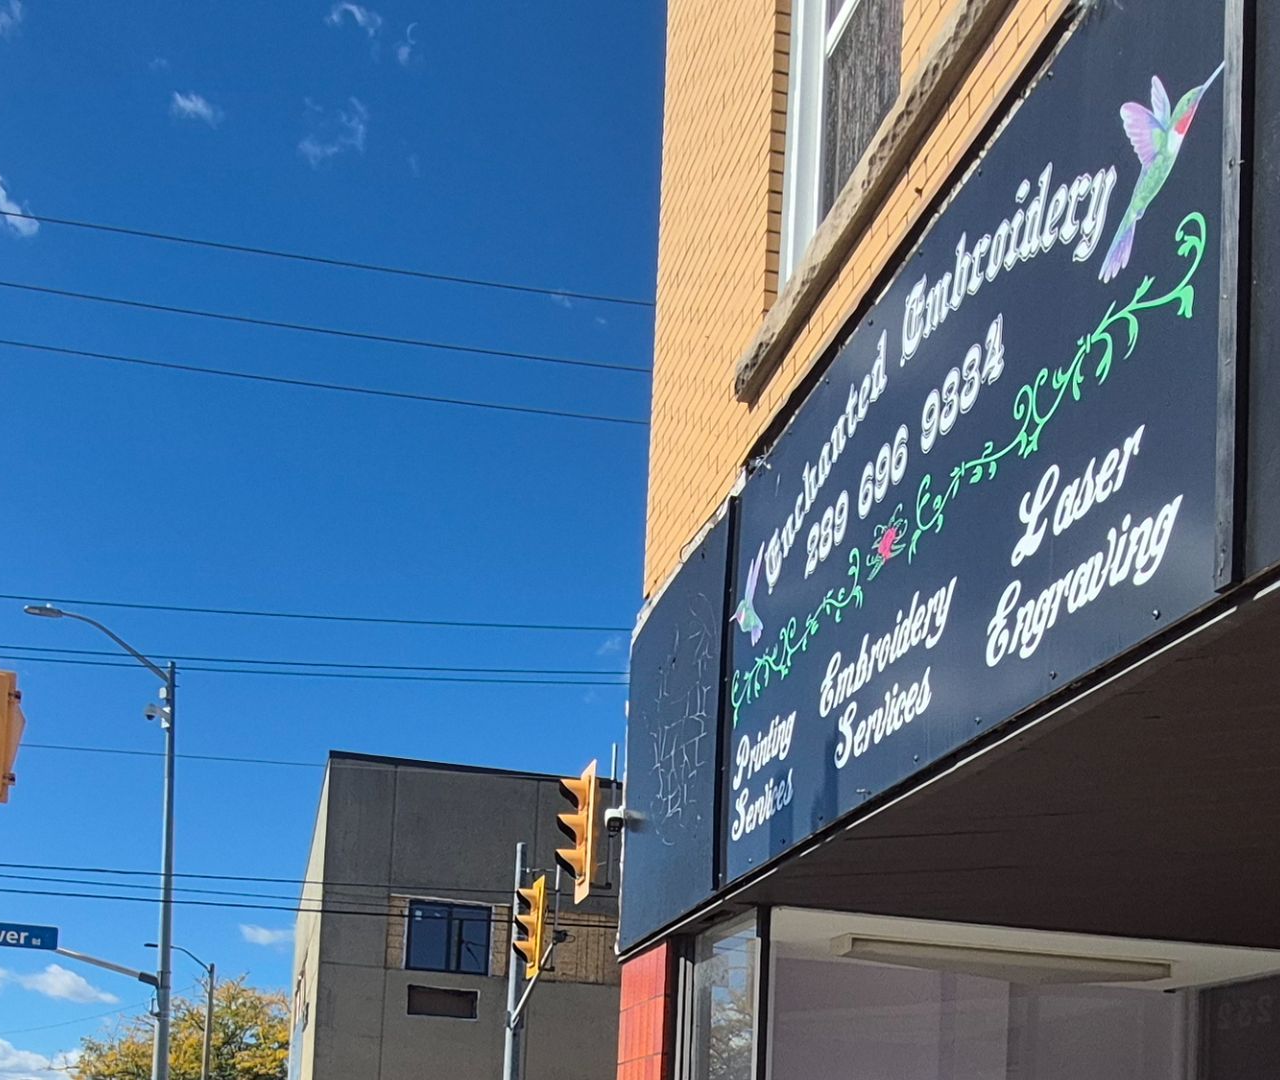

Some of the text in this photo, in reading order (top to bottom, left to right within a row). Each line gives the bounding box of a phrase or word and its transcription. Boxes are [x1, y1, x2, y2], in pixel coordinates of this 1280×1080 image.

[764, 161, 1118, 594] Enchanted Embroidery
[805, 313, 1005, 579] 289 696 9334
[1011, 424, 1145, 567] Laser
[819, 576, 957, 718] Embroidery
[986, 494, 1183, 668] Engraving
[733, 710, 796, 791] Printing
[834, 666, 932, 769] Services
[731, 769, 794, 841] Services
